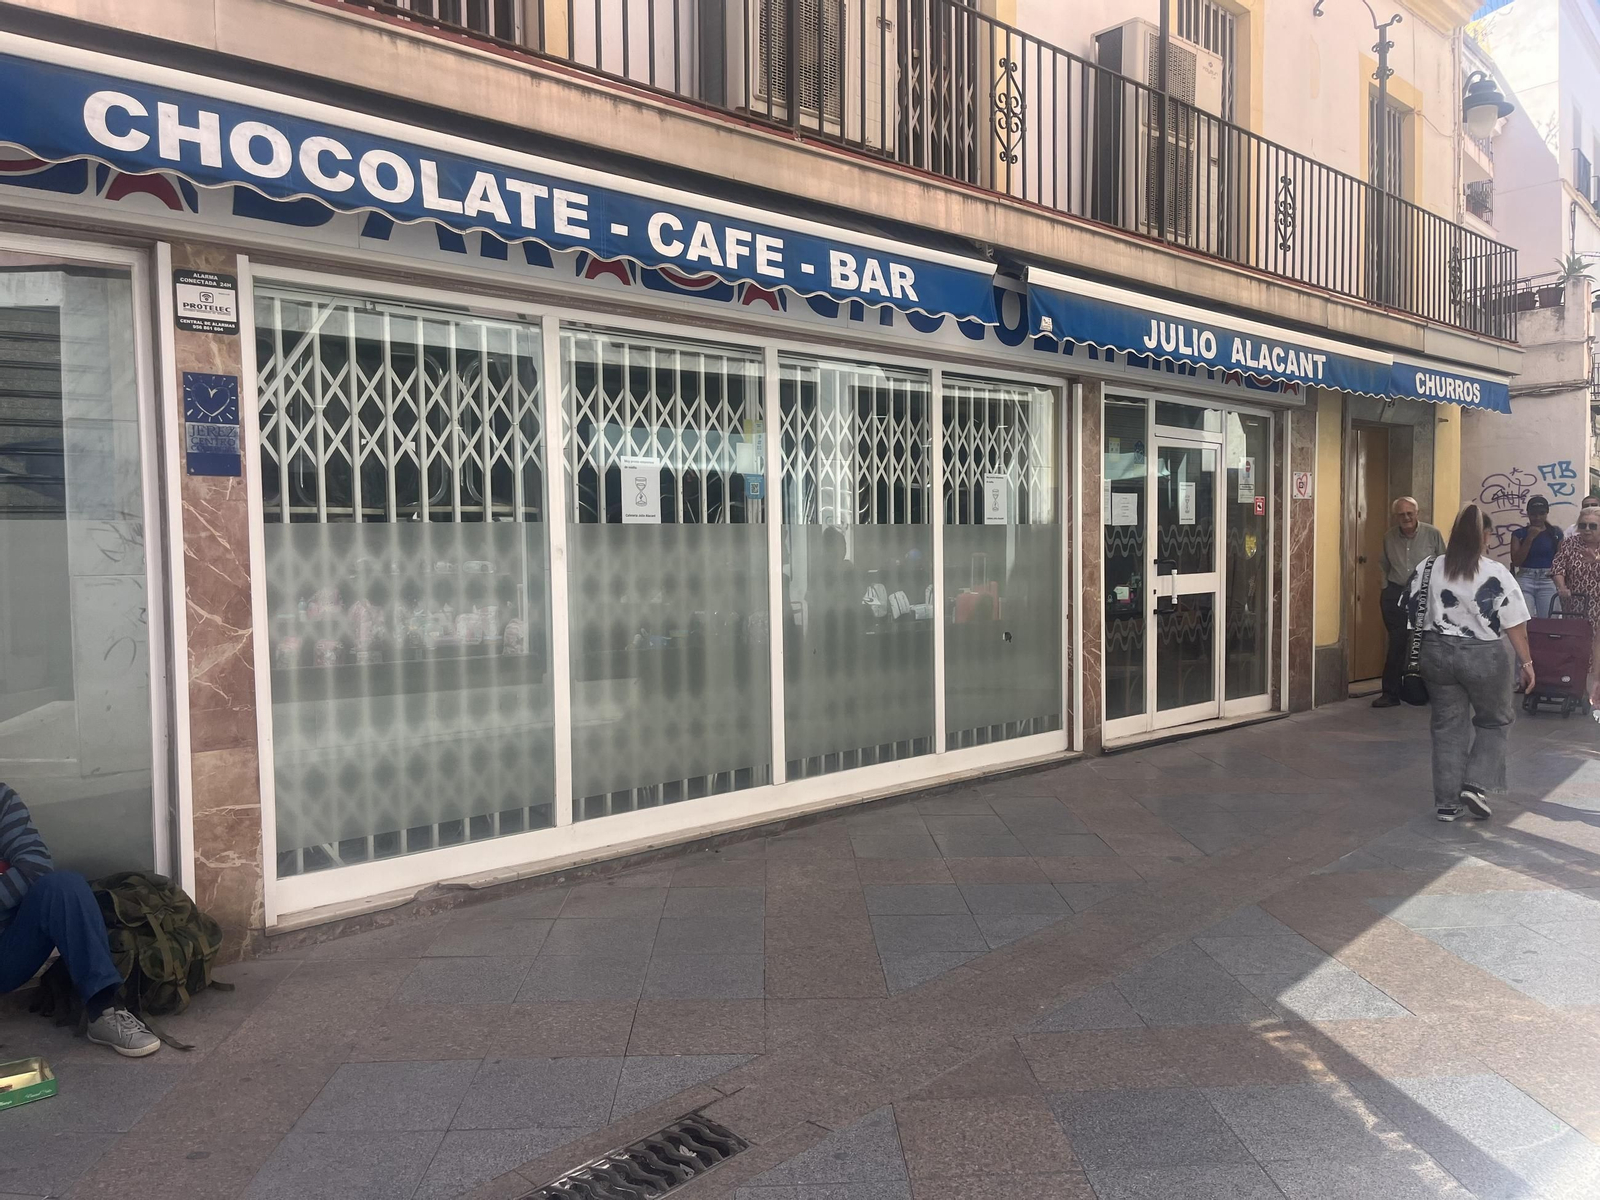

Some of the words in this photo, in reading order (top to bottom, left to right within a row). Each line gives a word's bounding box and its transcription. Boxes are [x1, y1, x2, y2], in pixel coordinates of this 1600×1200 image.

[83, 90, 591, 240] CHOCOLATE
[647, 212, 785, 278] CAFE
[829, 250, 919, 301] BAR
[180, 277, 217, 286] CONECTADA
[182, 302, 231, 312] PROTELEC
[1143, 319, 1217, 360] JULIO
[1231, 337, 1327, 379] ALACANT
[1415, 372, 1481, 404] CHURROS
[189, 425, 237, 437] JEREZ
[191, 437, 236, 447] CENTRO
